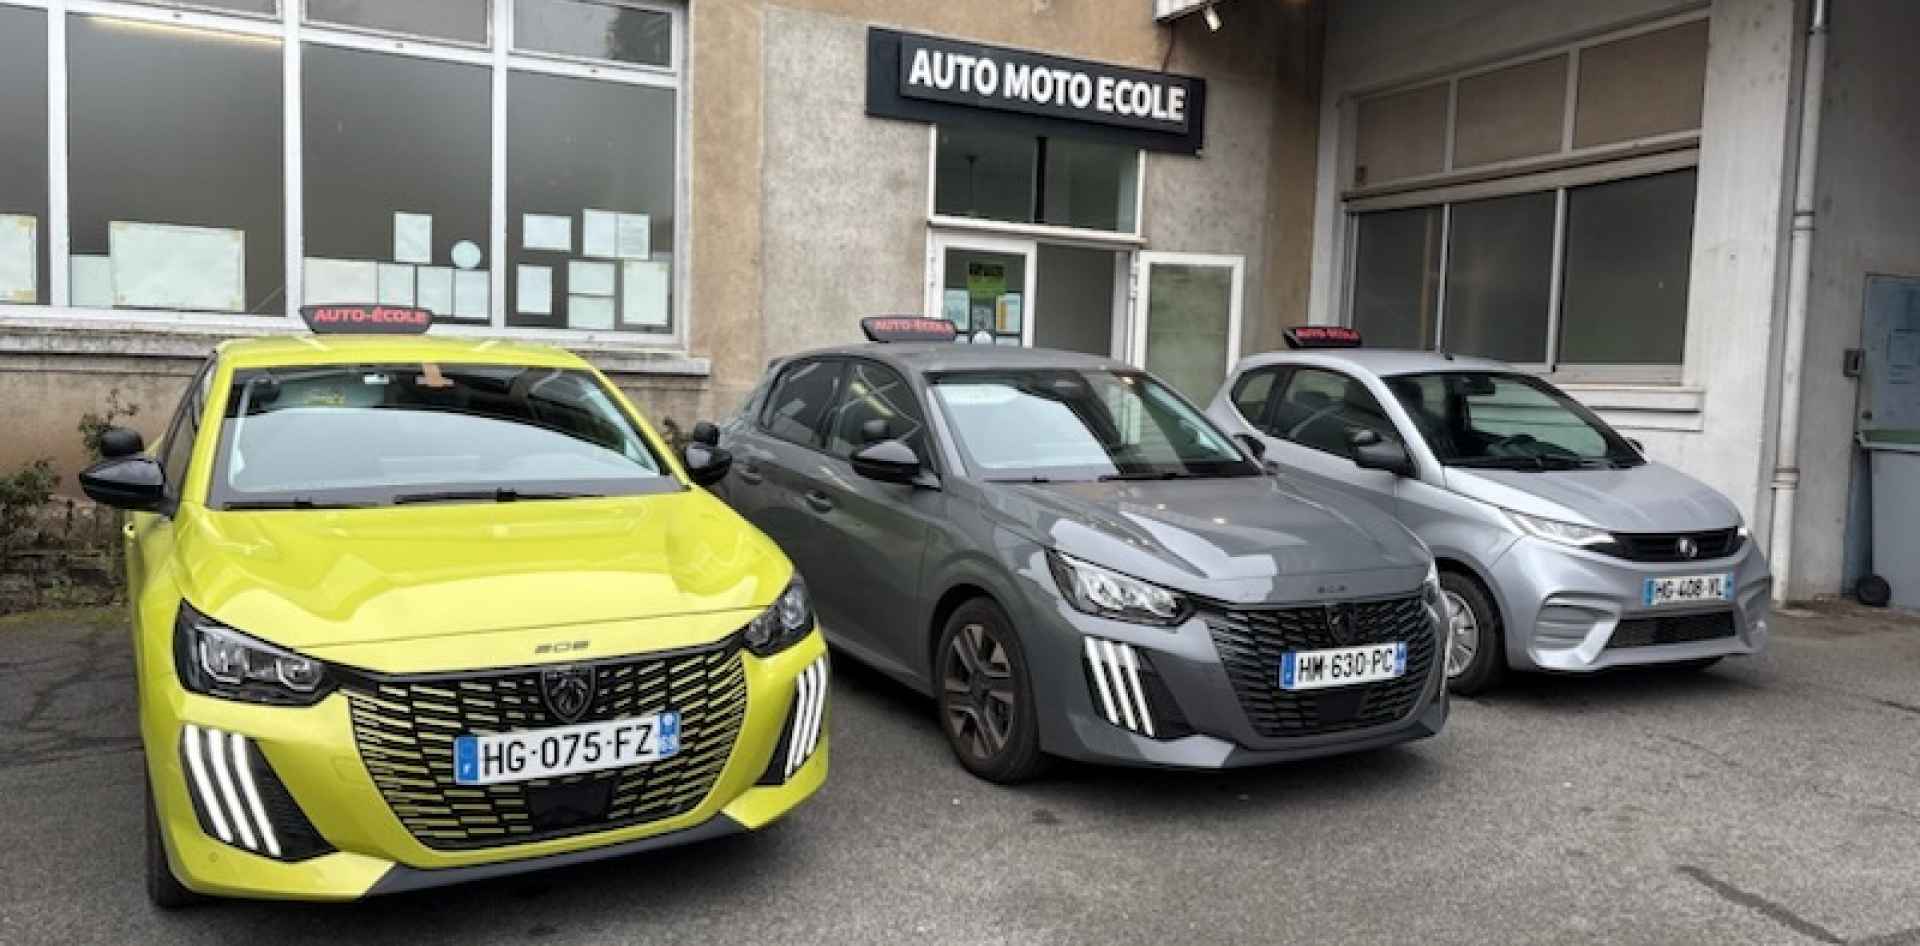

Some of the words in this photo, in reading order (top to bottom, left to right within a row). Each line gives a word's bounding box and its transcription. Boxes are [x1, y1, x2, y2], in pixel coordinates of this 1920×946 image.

[909, 48, 998, 96] AUTO
[1004, 62, 1093, 108] MOTO
[1097, 76, 1186, 121] ECOLE
[314, 305, 428, 324] AUTO-ÉCOLE
[483, 724, 654, 777] HG-075-FZ
